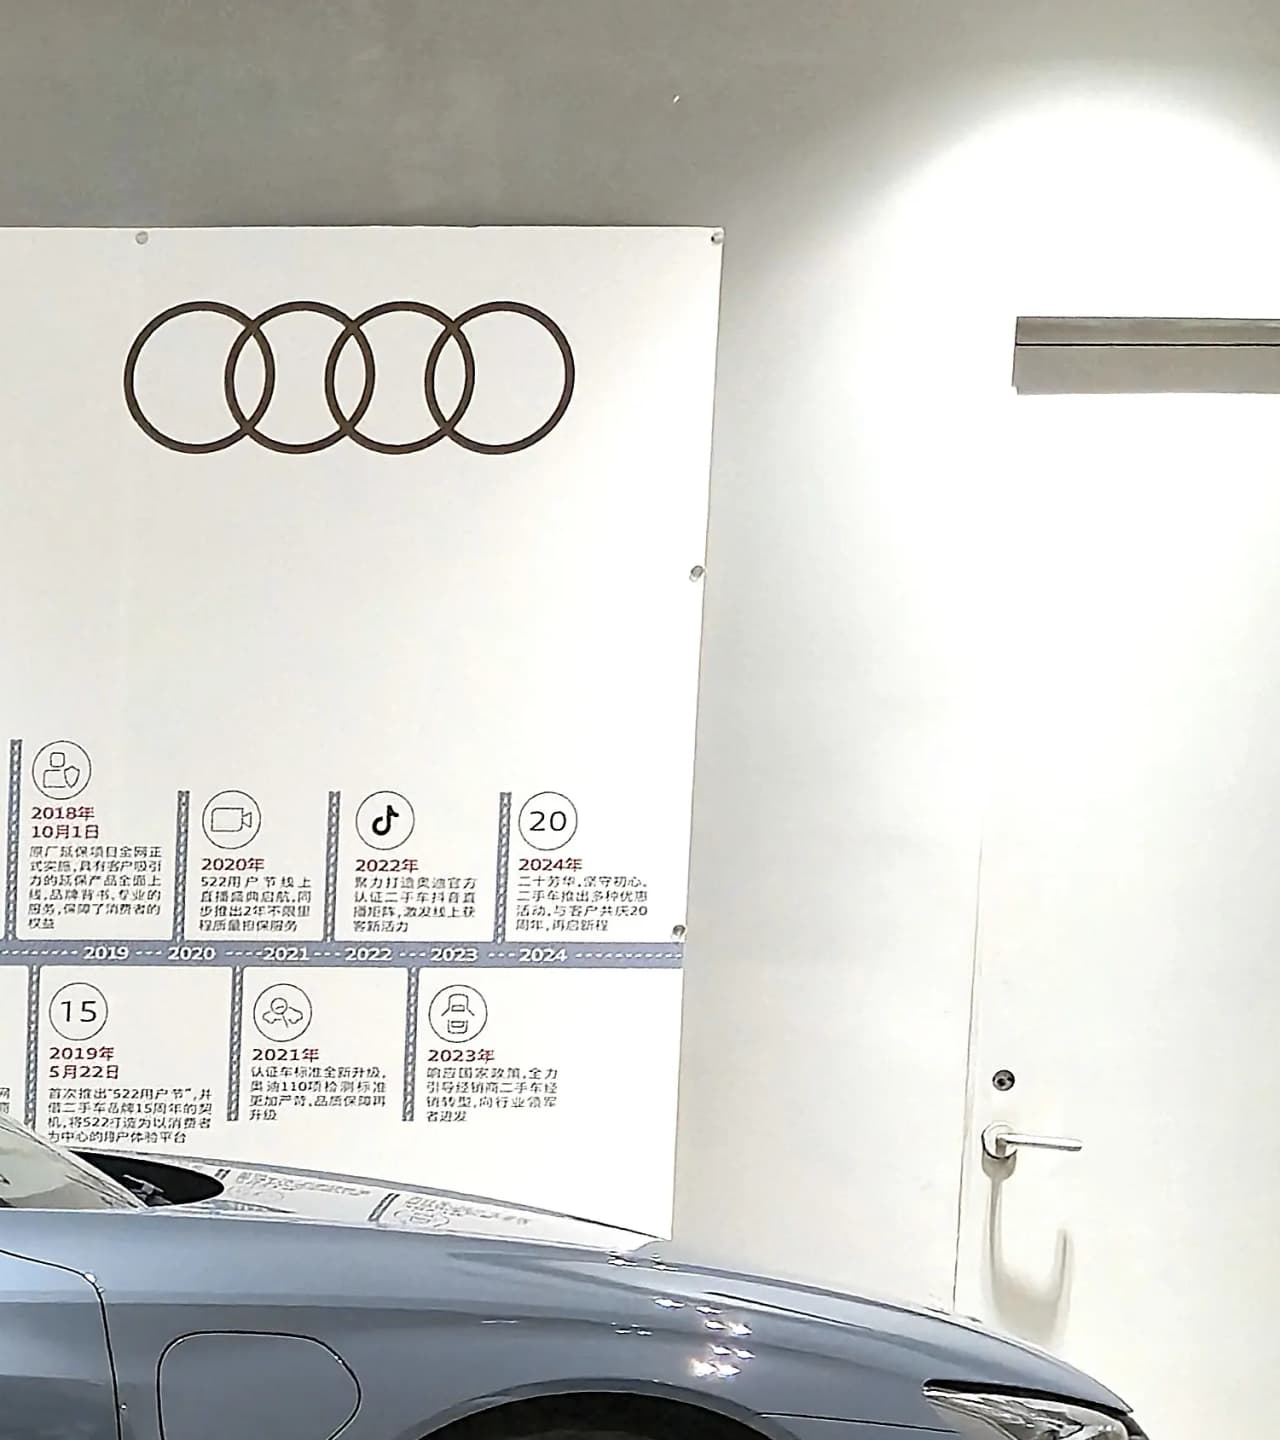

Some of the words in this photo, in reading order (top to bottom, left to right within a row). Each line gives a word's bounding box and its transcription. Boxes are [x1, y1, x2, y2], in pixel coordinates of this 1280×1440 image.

[31, 806, 96, 821] 2018年
[528, 810, 568, 833] 20
[31, 825, 100, 840] 10月1日
[200, 858, 265, 873] 2020年
[355, 858, 420, 874] 2022年
[518, 857, 583, 873] 2024年
[27, 918, 56, 930] 权益
[83, 946, 129, 961] 2019
[167, 946, 216, 961] 2020
[263, 946, 310, 961] 2021
[344, 947, 393, 962] 2022
[430, 947, 478, 962] 2023
[519, 947, 568, 962] 2024
[61, 1000, 98, 1024] 15
[49, 1046, 116, 1061] 2019年
[252, 1048, 320, 1063] 2021年
[427, 1049, 496, 1064] 2023年
[48, 1064, 120, 1080] 5月22日
[248, 1108, 278, 1122] 升级
[426, 1110, 468, 1123] 者进发
[47, 1130, 187, 1144] 为中心的用户体验平台
